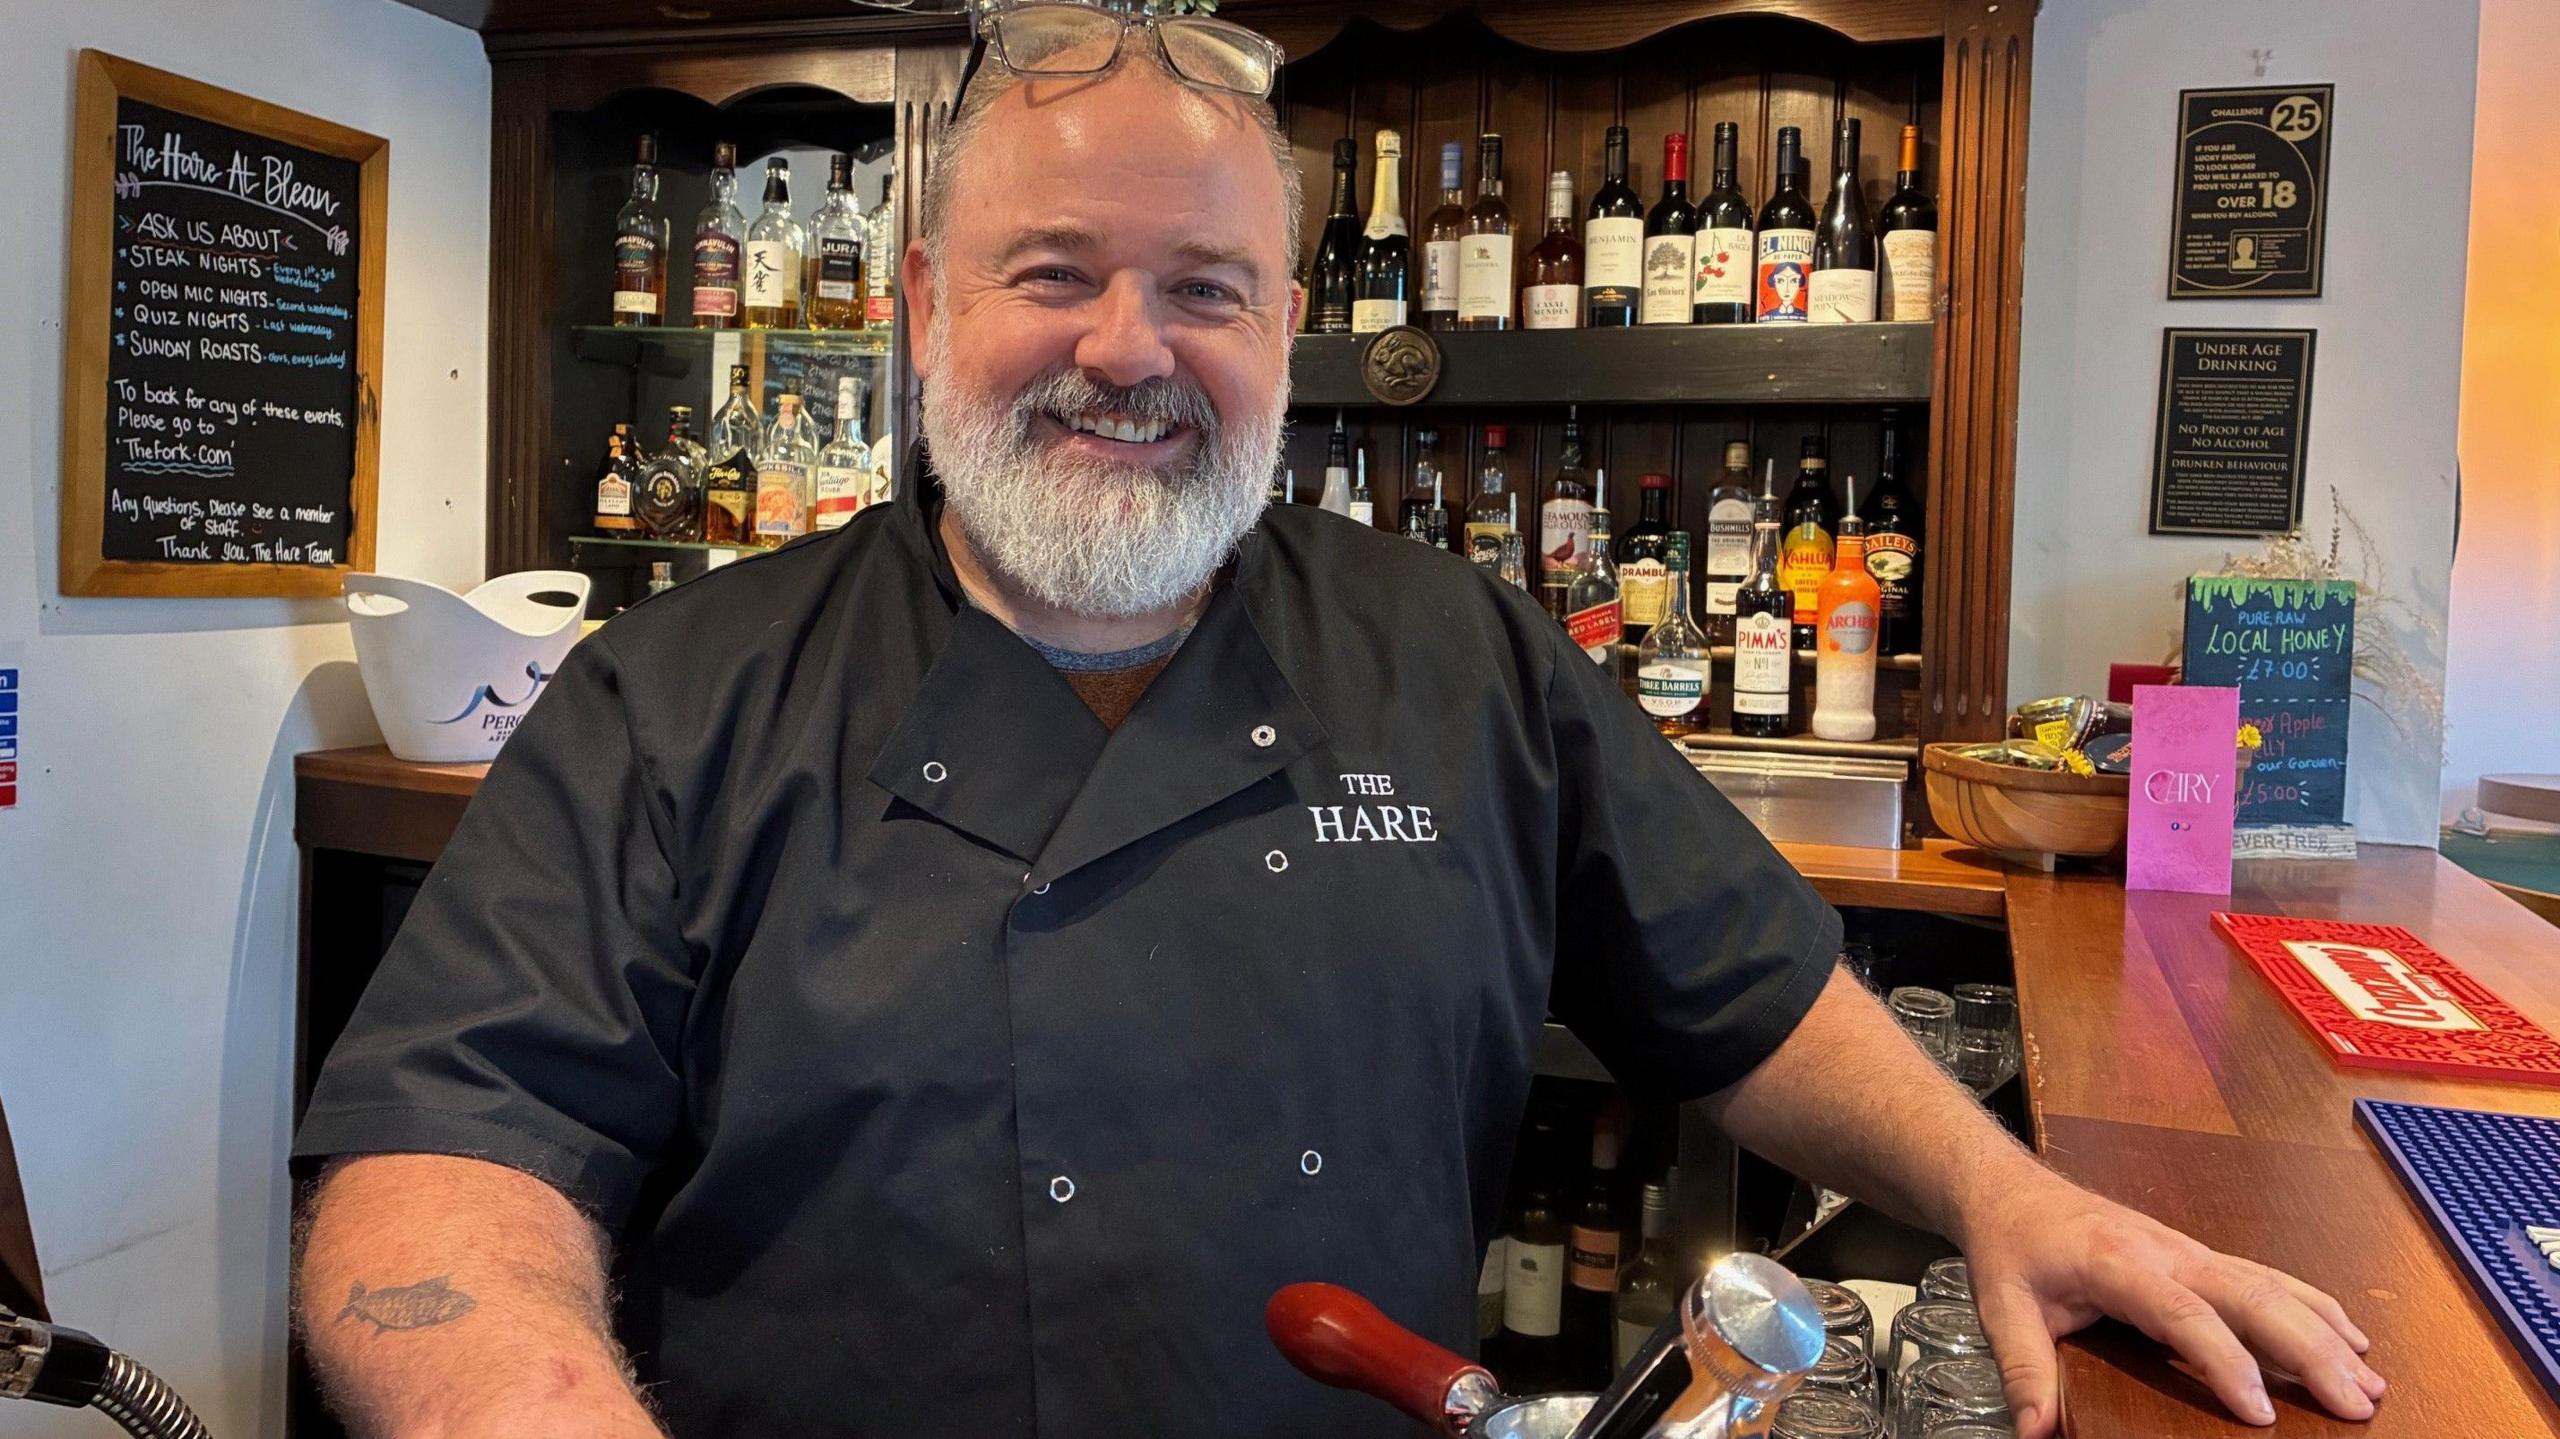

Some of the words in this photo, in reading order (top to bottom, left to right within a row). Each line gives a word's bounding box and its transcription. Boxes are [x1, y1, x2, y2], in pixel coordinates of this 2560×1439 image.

[2212, 107, 2264, 117] CHALLENGE
[2276, 104, 2317, 132] 25
[119, 124, 161, 173] The
[160, 133, 222, 183] Hare
[227, 150, 259, 197] At
[262, 156, 339, 216] Blean
[2217, 196, 2257, 208] OVER
[2259, 180, 2297, 209] 18
[138, 213, 178, 240] ASK
[188, 221, 214, 245] US
[221, 226, 280, 252] ABOUT
[130, 246, 190, 267] STEAK
[822, 242, 858, 254] JURA
[141, 280, 177, 299] OPEN
[184, 284, 213, 301] MIC
[134, 304, 180, 324] QUIZ
[188, 314, 249, 333] NIGHTS
[131, 330, 191, 360] SUNDAY
[2196, 342, 2249, 356] UNDER
[2252, 344, 2282, 356] AGE
[2199, 358, 2277, 372] DRINKING
[115, 379, 136, 401] To
[144, 382, 179, 405] book
[186, 390, 206, 409] for
[210, 401, 237, 426] any
[242, 399, 257, 416] of
[262, 402, 299, 420] these
[119, 407, 166, 430] Please
[173, 420, 191, 438] go
[197, 420, 214, 435] to
[2202, 424, 2239, 436] PROOF
[2192, 437, 2210, 448] NO
[2214, 438, 2270, 449] ALCOHOL
[2172, 459, 2224, 470] DRUNKEN
[2228, 460, 2288, 471] BEHAVIOUR
[112, 489, 138, 522] Any
[280, 510, 290, 520] a
[296, 504, 334, 523] member
[181, 516, 196, 530] of
[1710, 524, 1750, 532] BUSHMILLS
[156, 535, 211, 560] Thank
[252, 542, 272, 561] The
[276, 538, 300, 561] Hare
[305, 542, 334, 563] Team
[1865, 537, 1914, 552] BAILEYS
[1623, 568, 1667, 577] DRAMBU
[1881, 586, 1909, 594] GINAL
[1588, 616, 1616, 629] LABEL
[2276, 611, 2306, 625] RAW
[1739, 628, 1787, 649] PIMM'S
[2206, 625, 2271, 655] LOCAL
[2281, 623, 2346, 655] HONEY
[1662, 681, 1699, 691] BARRELS
[2280, 712, 2326, 738] Apple
[2257, 763, 2283, 771] our
[1339, 774, 1395, 795] THE
[1307, 804, 1438, 842] HARE
[2234, 833, 2328, 850] EVER-TREE
